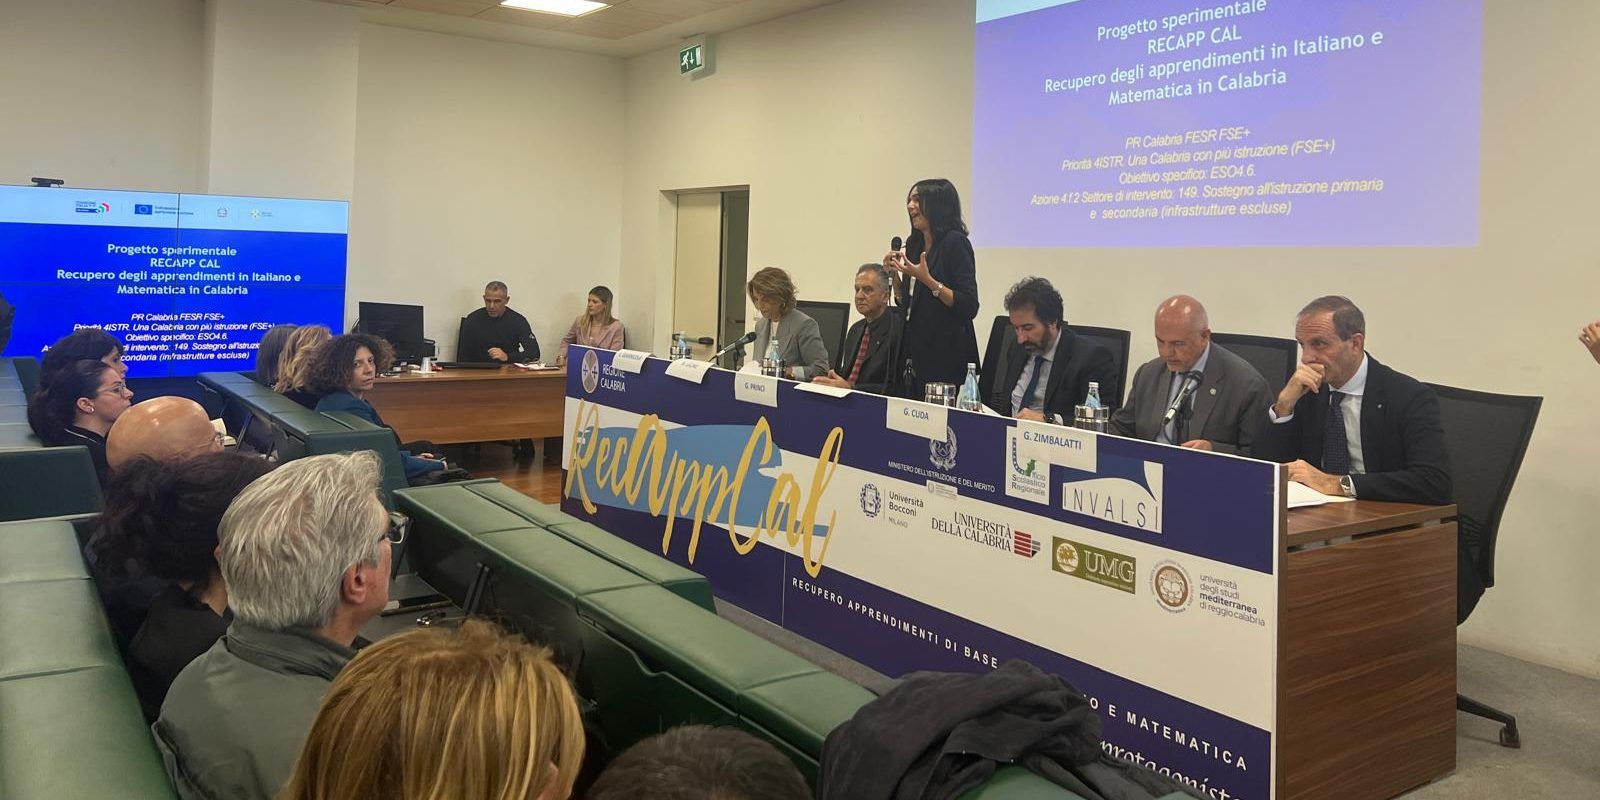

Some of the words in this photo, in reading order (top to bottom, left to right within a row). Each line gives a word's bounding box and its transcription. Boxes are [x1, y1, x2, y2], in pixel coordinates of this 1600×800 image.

[1097, 19, 1158, 41] Progetto
[1162, 0, 1266, 31] sperimentale
[1148, 30, 1206, 54] RECAPP
[1210, 24, 1242, 44] CAL
[1045, 73, 1106, 92] Recupero
[1110, 64, 1144, 84] degli
[1149, 45, 1264, 79] apprendimenti
[1271, 43, 1287, 59] in
[1294, 34, 1364, 56] Italiano
[1371, 31, 1384, 44] e
[1108, 83, 1192, 106] Matematica
[1198, 79, 1212, 94] in
[1218, 68, 1287, 92] Calabria
[1126, 136, 1141, 150] PR
[1142, 132, 1183, 148] Calabria
[1184, 130, 1216, 144] FESR
[1219, 126, 1250, 140] FSE+
[1128, 154, 1148, 167] Una
[1150, 151, 1191, 165] Calabria
[1193, 152, 1212, 162] con
[1214, 147, 1232, 162] più
[1234, 144, 1288, 158] istruzione
[1291, 138, 1335, 156] (FSE+)
[1119, 171, 1160, 184] Obiettivo
[1030, 194, 1060, 206] Azione
[1081, 190, 1113, 203] Settore
[1114, 190, 1124, 202] di
[1202, 184, 1254, 200] Sostegno
[1256, 180, 1328, 196] all'istruzione
[1330, 178, 1384, 196] primaria
[1090, 210, 1096, 220] e
[1102, 206, 1158, 220] secondaria
[1161, 202, 1236, 218] (infrastrutture
[1240, 201, 1292, 216] escluse)
[108, 244, 158, 258] Progetto
[162, 245, 237, 258] sperimentale
[150, 258, 196, 268] RECAPP
[199, 258, 220, 268] CAL
[57, 270, 115, 282] Recupero
[119, 270, 148, 282] degli
[151, 271, 235, 282] apprendimenti
[238, 271, 248, 282] in
[252, 272, 292, 282] Italiano
[294, 274, 302, 282] e
[117, 284, 186, 294] Matematica
[190, 285, 200, 294] in
[204, 285, 248, 295] Calabria
[146, 313, 178, 321] Calabria
[200, 324, 212, 332] più
[214, 322, 248, 330] istruzione
[192, 342, 227, 352] Sostegno
[160, 352, 215, 362] (infrastrutture
[217, 352, 250, 360] escluse)
[600, 378, 626, 392] CALABRIA
[912, 410, 929, 420] CUDA
[1024, 431, 1032, 440] G.
[1034, 432, 1082, 450] ZIMBALATTI
[888, 460, 914, 473] MINISTERO
[914, 467, 957, 484] DELL'ISTRUZIONE
[962, 478, 974, 488] DEL
[974, 480, 996, 494] MERITO
[1012, 474, 1046, 488] Scolastico
[1012, 482, 1046, 496] Regionale
[889, 490, 924, 508] Università
[1064, 485, 1158, 530] INVALSI
[888, 501, 917, 516] Bocconi
[888, 516, 908, 528] MILANO
[954, 512, 1012, 540] UNIVERSITÀ
[932, 517, 962, 538] DELLA
[964, 527, 1012, 552] CALABRIA
[1084, 550, 1134, 582] UMG
[1200, 574, 1238, 590] università
[1200, 583, 1219, 594] degli
[1220, 588, 1240, 600] studi
[1200, 592, 1258, 614] mediterranea
[1200, 602, 1207, 610] di
[1208, 605, 1233, 618] reggio
[1234, 610, 1266, 626] calabria
[792, 577, 843, 606] RECUPERO
[848, 600, 938, 644] APPRENDIMENTI
[945, 638, 957, 652] DI
[964, 646, 998, 670] BASE
[1108, 704, 1117, 718] E
[1126, 711, 1247, 771] MATEMATICA
